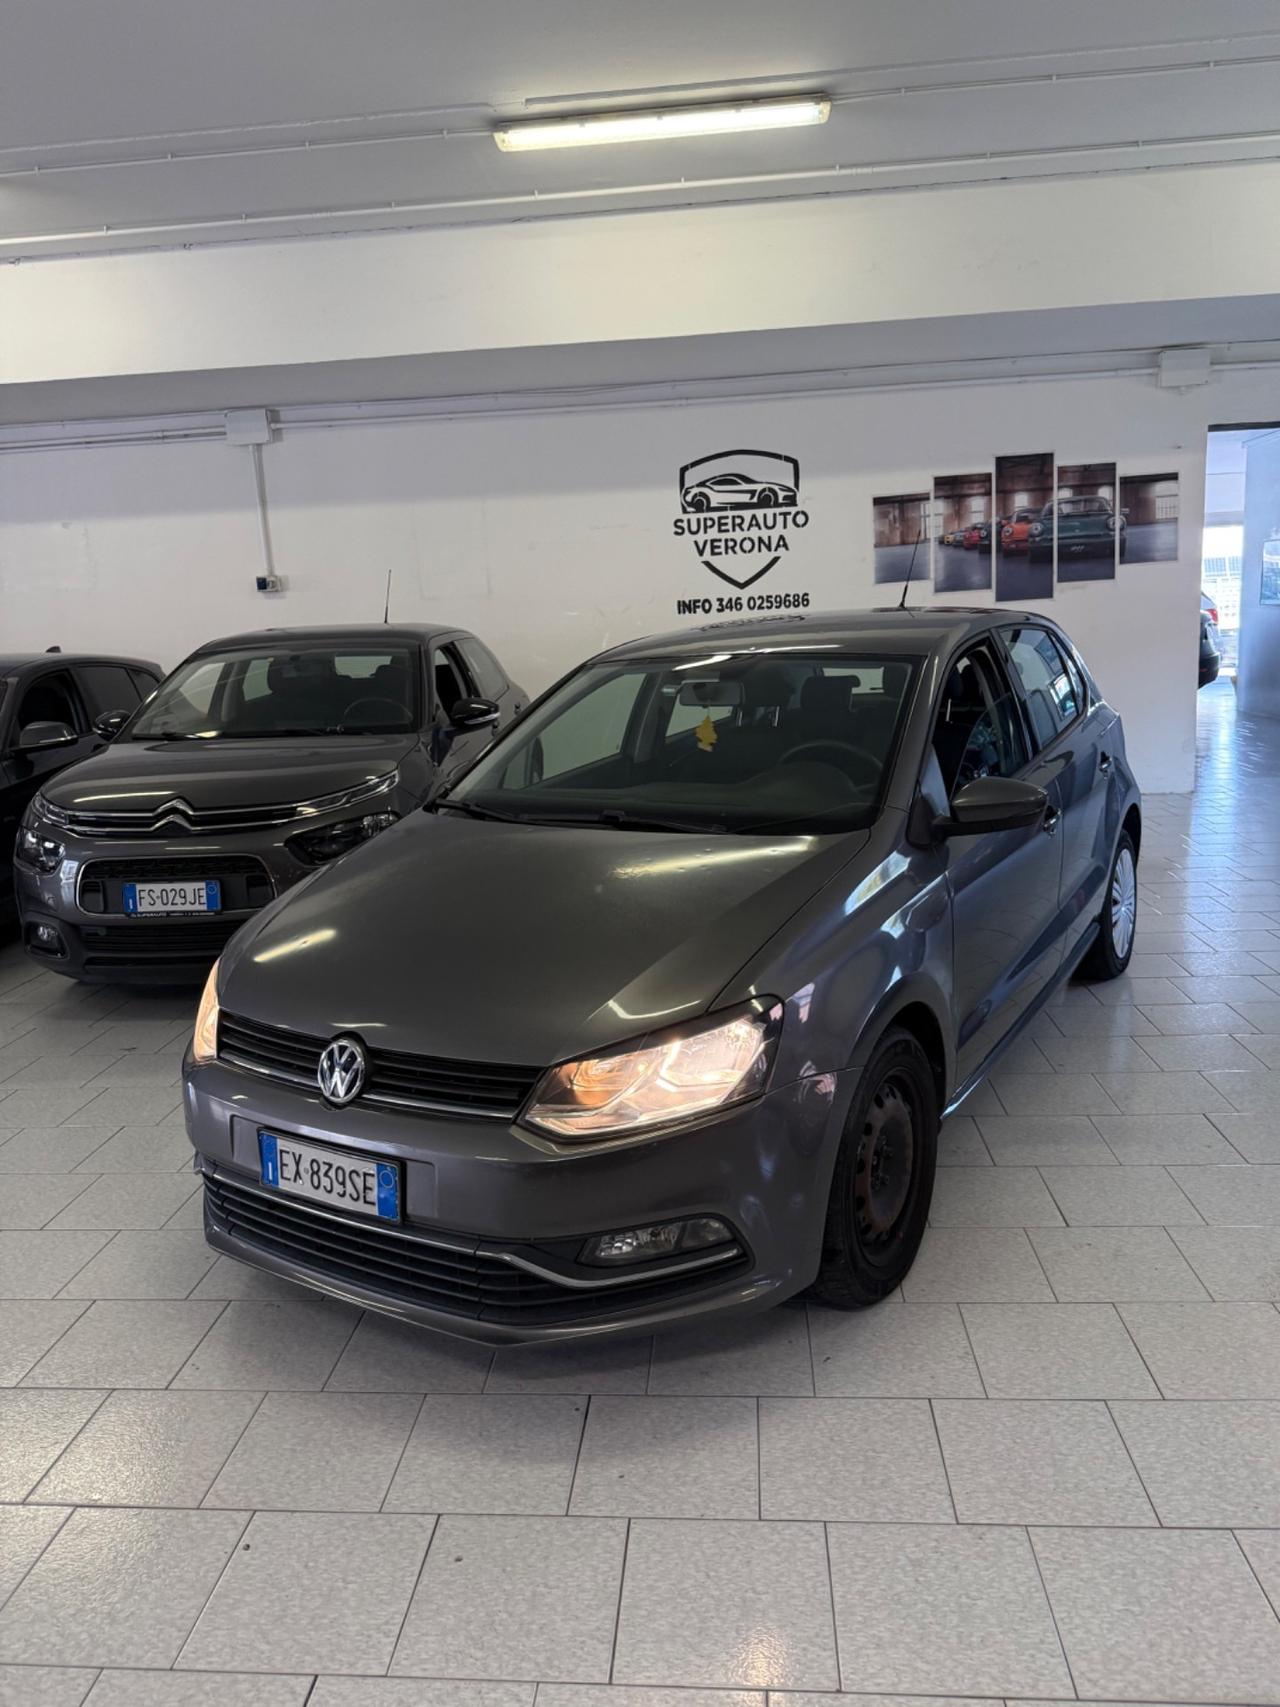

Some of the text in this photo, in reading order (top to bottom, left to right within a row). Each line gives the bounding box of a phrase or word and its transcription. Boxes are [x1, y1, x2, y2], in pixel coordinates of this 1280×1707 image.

[673, 510, 810, 536] SUPERAUTO
[693, 534, 790, 557] VERONA
[677, 592, 810, 615] INFO 346 0259686
